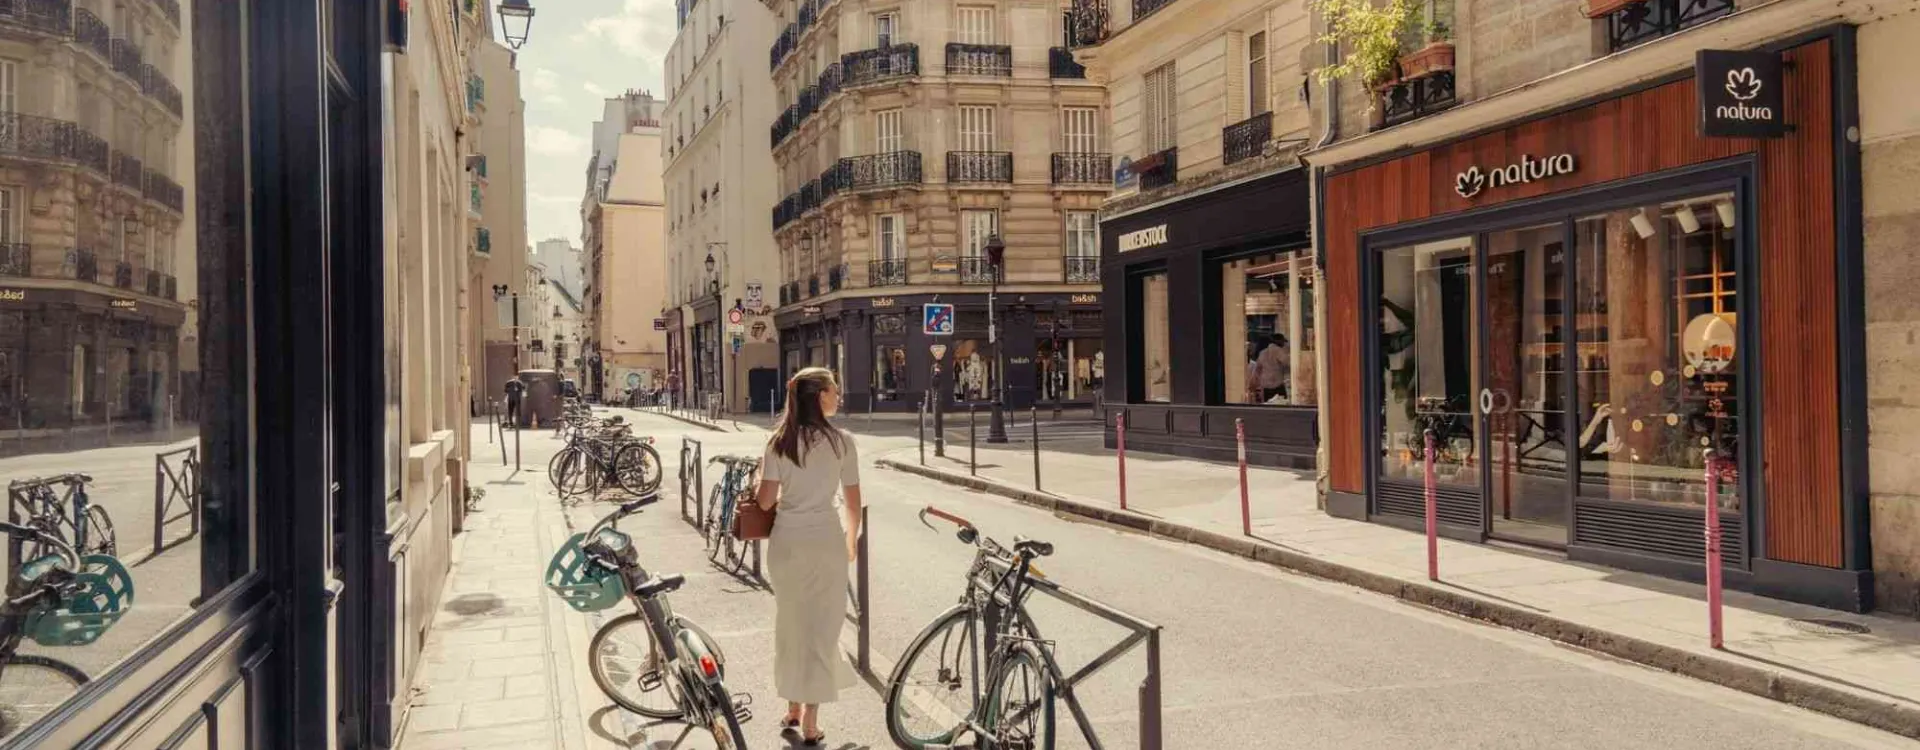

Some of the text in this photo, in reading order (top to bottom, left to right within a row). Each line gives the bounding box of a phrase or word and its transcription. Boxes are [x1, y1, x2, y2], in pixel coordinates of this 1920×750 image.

[1716, 102, 1772, 120] natura
[1489, 153, 1574, 188] natura
[1071, 293, 1097, 303] ba&sh
